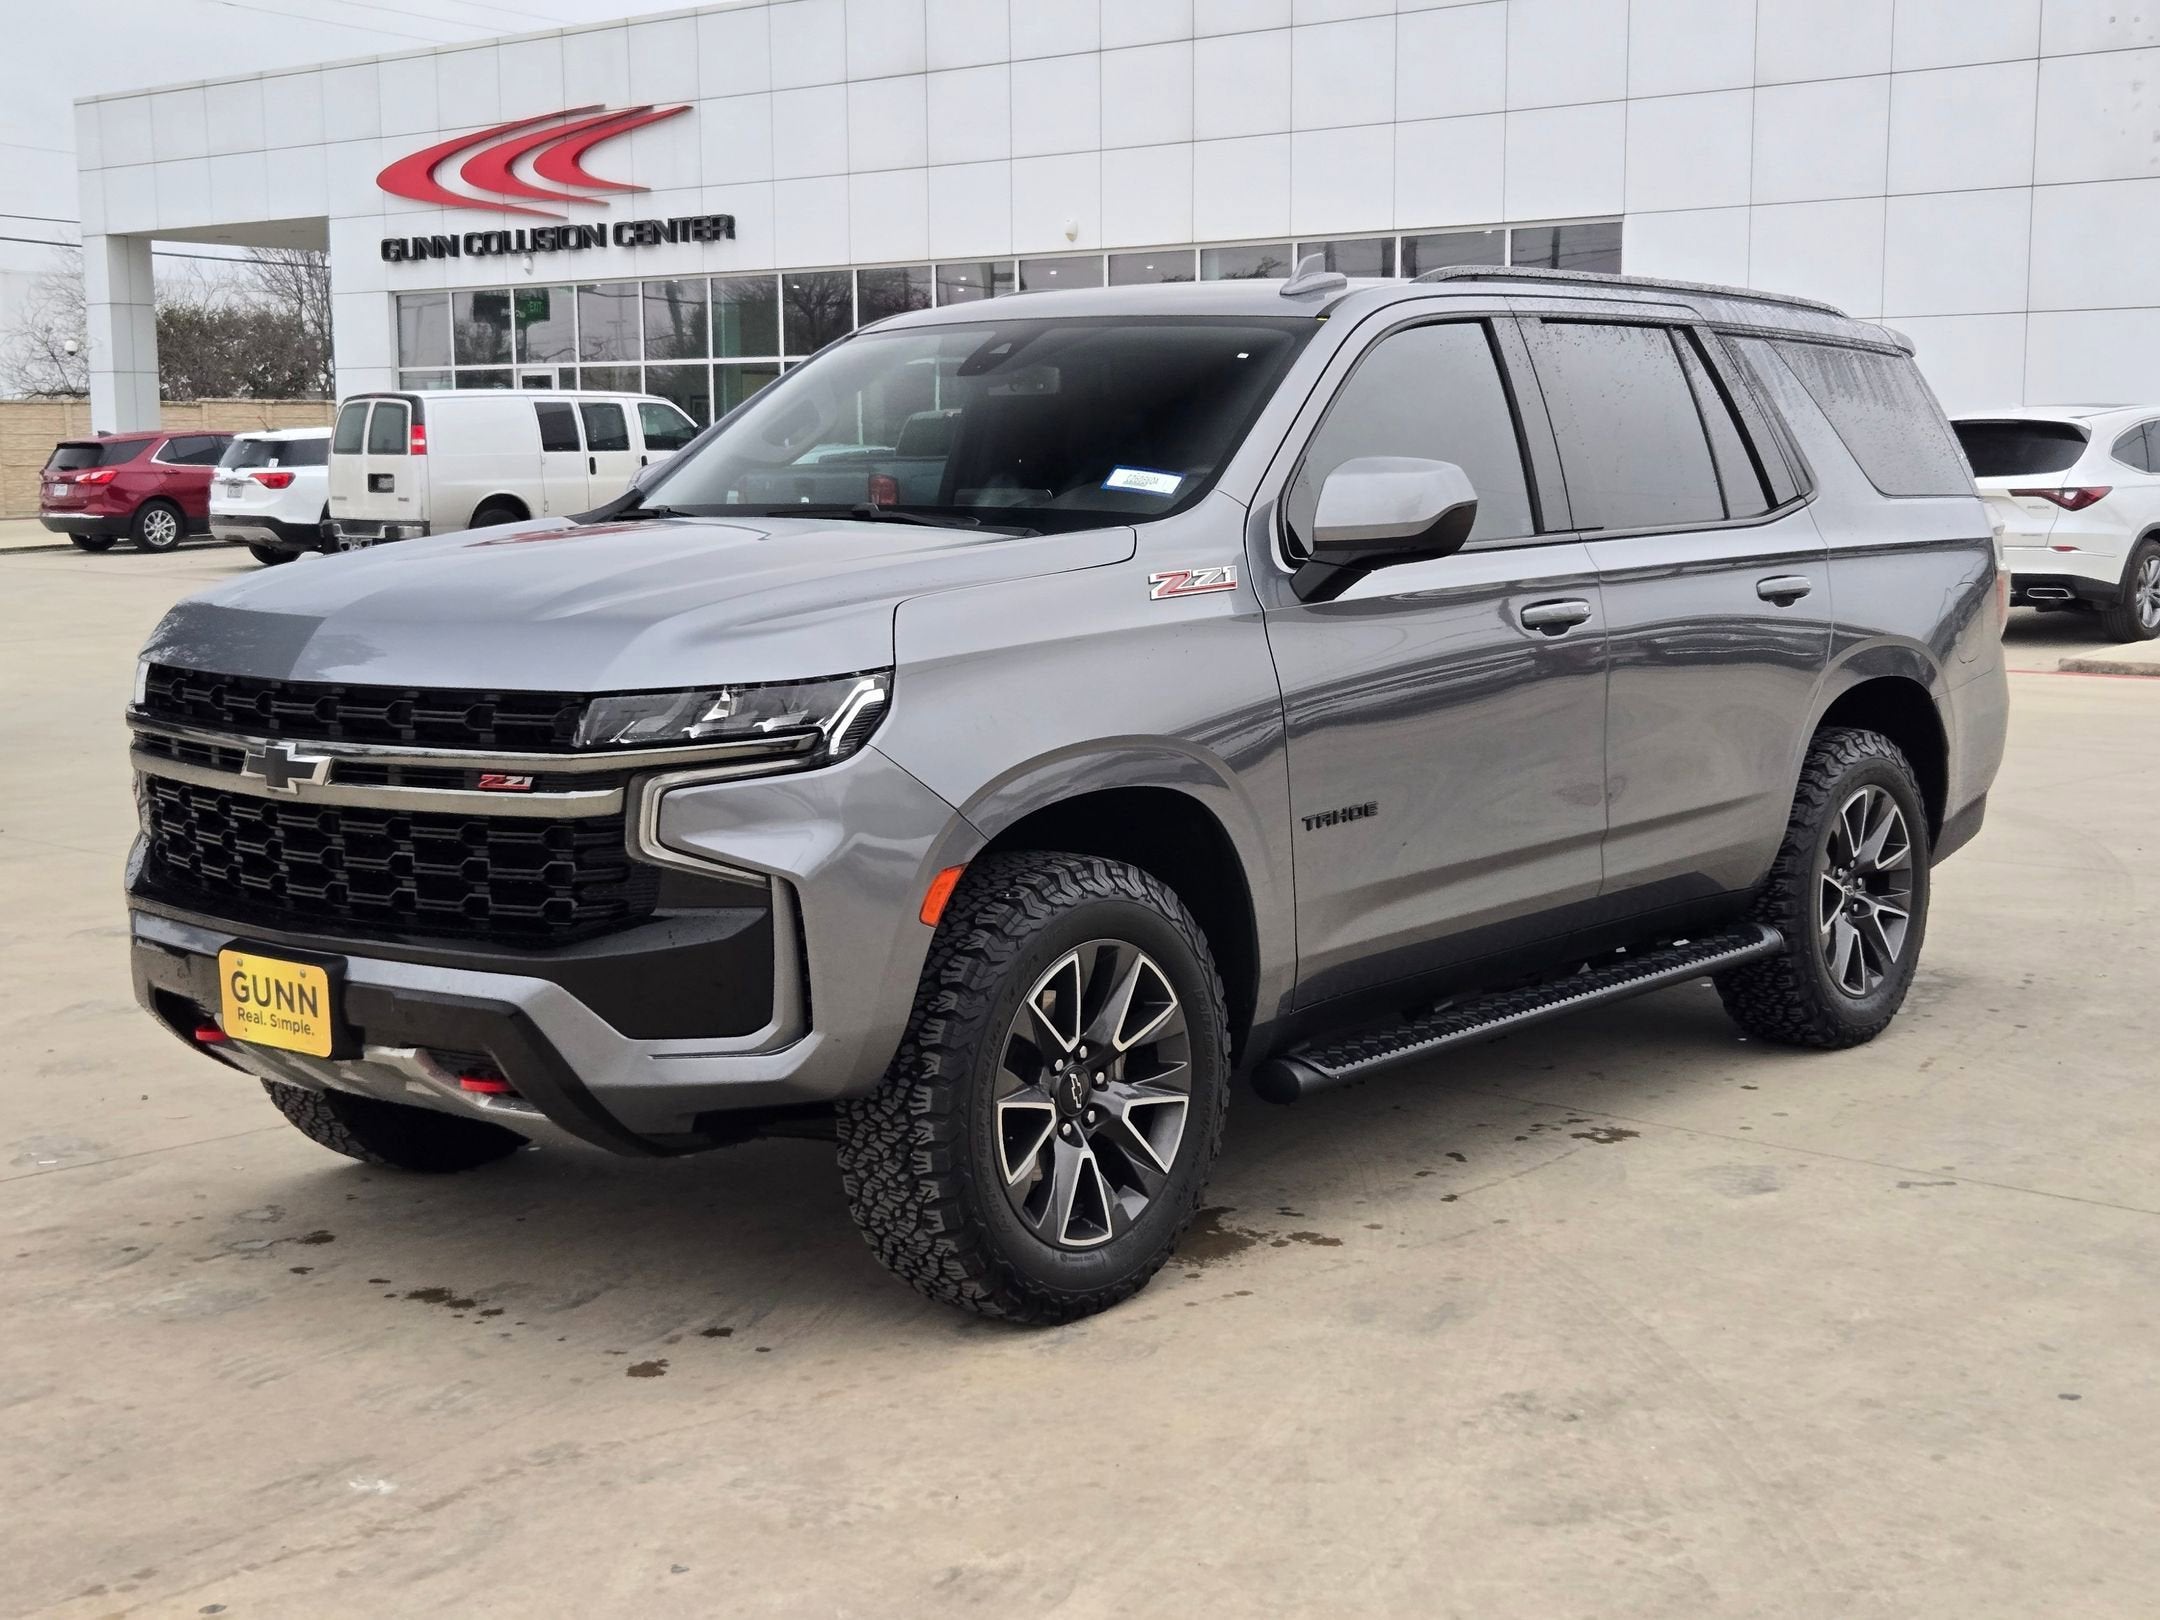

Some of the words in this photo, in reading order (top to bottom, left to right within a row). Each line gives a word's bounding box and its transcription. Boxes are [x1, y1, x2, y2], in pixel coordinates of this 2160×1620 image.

[381, 235, 460, 262] GUNN
[464, 223, 607, 257] COLLISION
[613, 214, 736, 247] CENTER
[1149, 565, 1238, 600] Z71
[479, 774, 534, 790] Z71
[1301, 801, 1379, 832] TAHOE
[231, 970, 319, 1018] GUNN
[237, 1006, 267, 1026] Real.
[270, 1013, 315, 1037] Simple.
